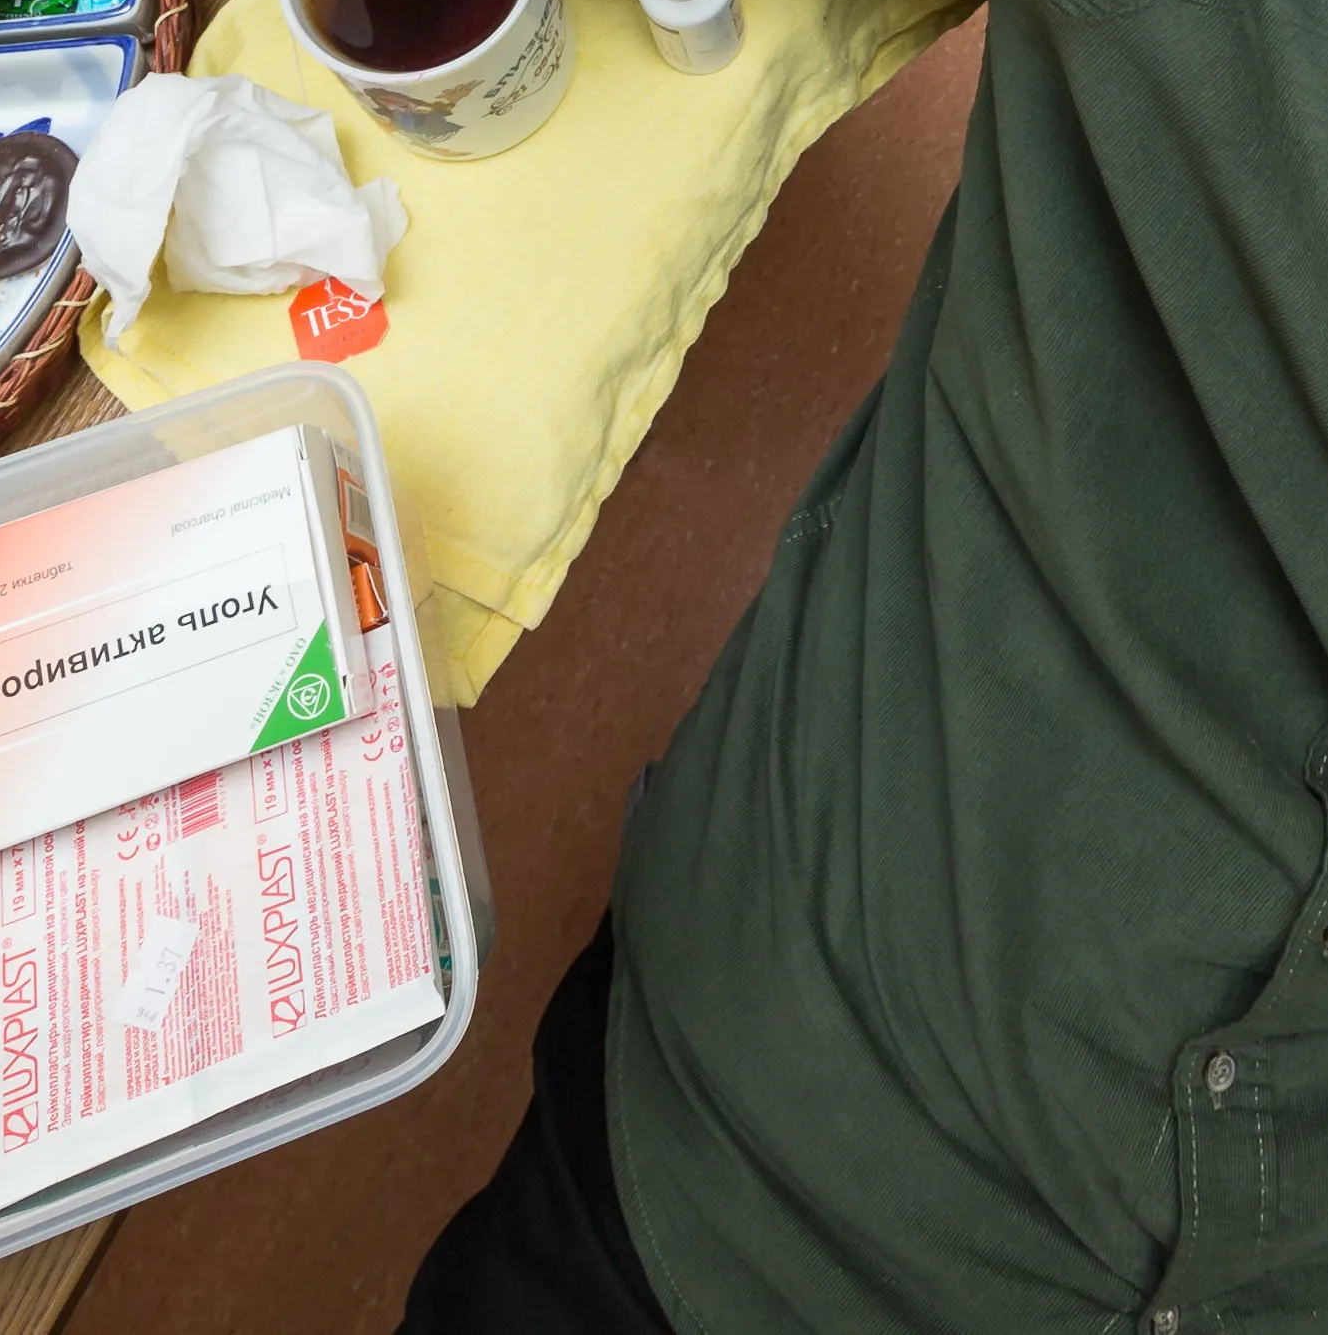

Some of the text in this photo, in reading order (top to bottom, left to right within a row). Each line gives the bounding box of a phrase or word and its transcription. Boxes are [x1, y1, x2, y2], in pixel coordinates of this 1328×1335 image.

[300, 290, 371, 337] TESS
[169, 485, 291, 537] Medicinal charcoal
[10, 560, 74, 593] таблетки
[178, 584, 281, 633] Уголь
[264, 792, 277, 812] 19
[292, 755, 307, 811] тканевой
[326, 774, 334, 789] на
[300, 811, 308, 824] на
[325, 788, 341, 851] LUXPLAST
[77, 873, 84, 889] на
[299, 827, 318, 915] медицинский
[332, 849, 349, 913] медичний
[13, 893, 25, 913] 19
[75, 889, 87, 954] LUXPLAST
[261, 841, 304, 997] LUXPLAST
[43, 829, 62, 1134] Лейкопластырь медицинский на тканевой осн
[76, 952, 91, 1021] медичний
[306, 913, 328, 1021] Лейкопластырь
[339, 911, 359, 1008] Лейкопластир
[2, 945, 38, 1109] LUXPLAST
[78, 1019, 94, 1120] Лейкопластир
